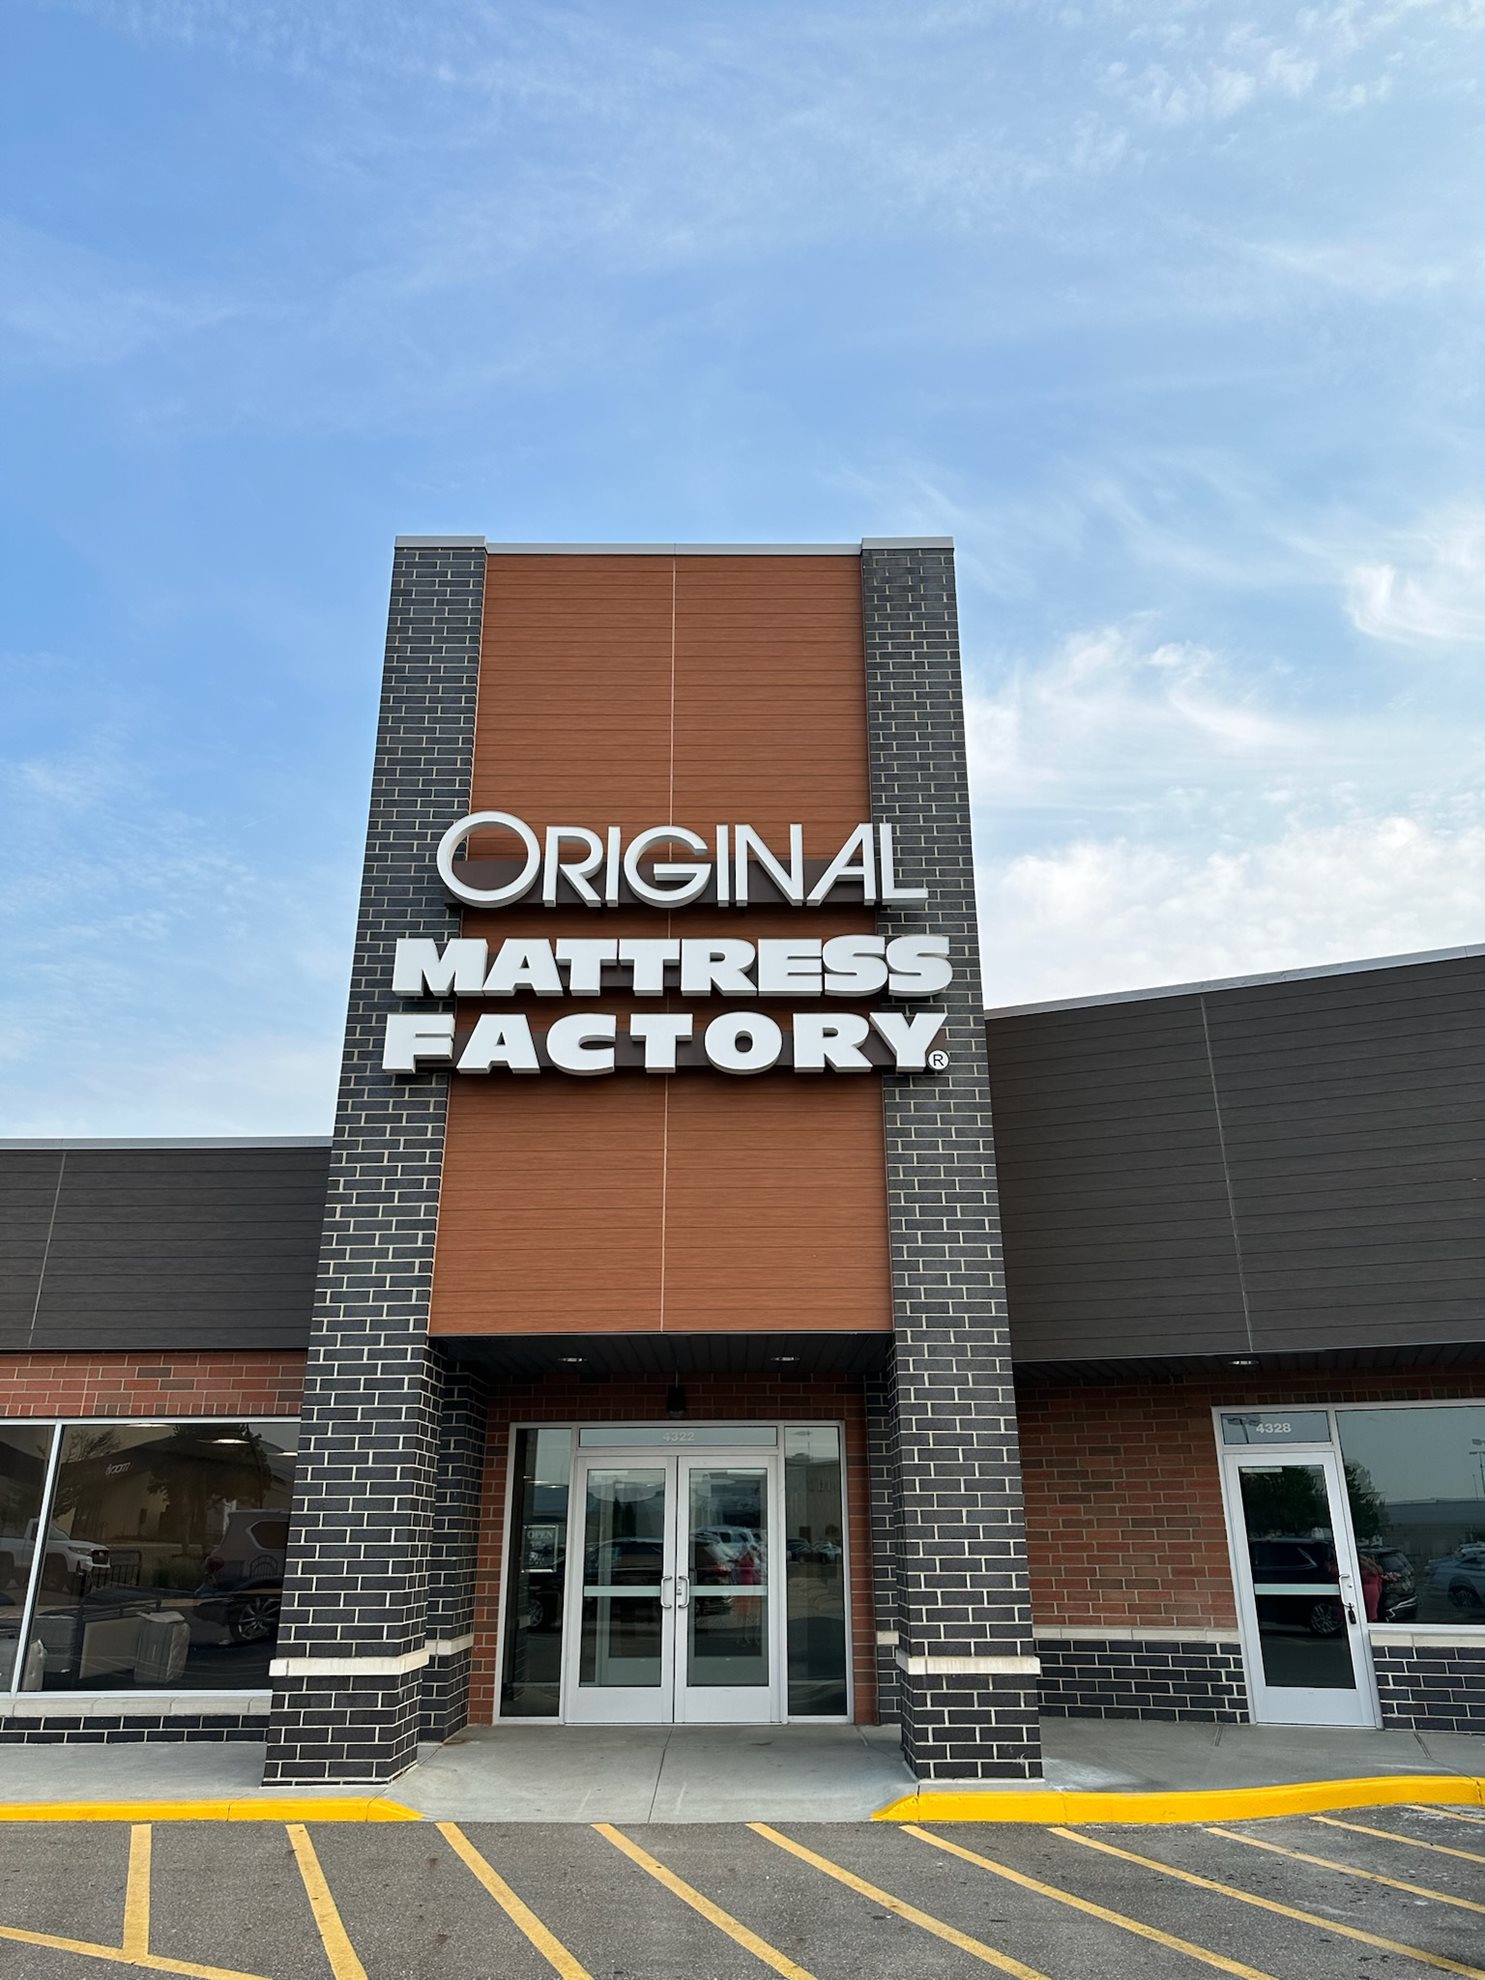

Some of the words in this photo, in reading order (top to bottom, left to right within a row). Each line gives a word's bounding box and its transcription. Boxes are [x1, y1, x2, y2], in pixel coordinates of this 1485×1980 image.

[436, 811, 928, 908] ORIGINAL
[391, 934, 953, 998] MATTRESS
[663, 1431, 695, 1441] 4322
[1256, 1423, 1292, 1433] 4328
